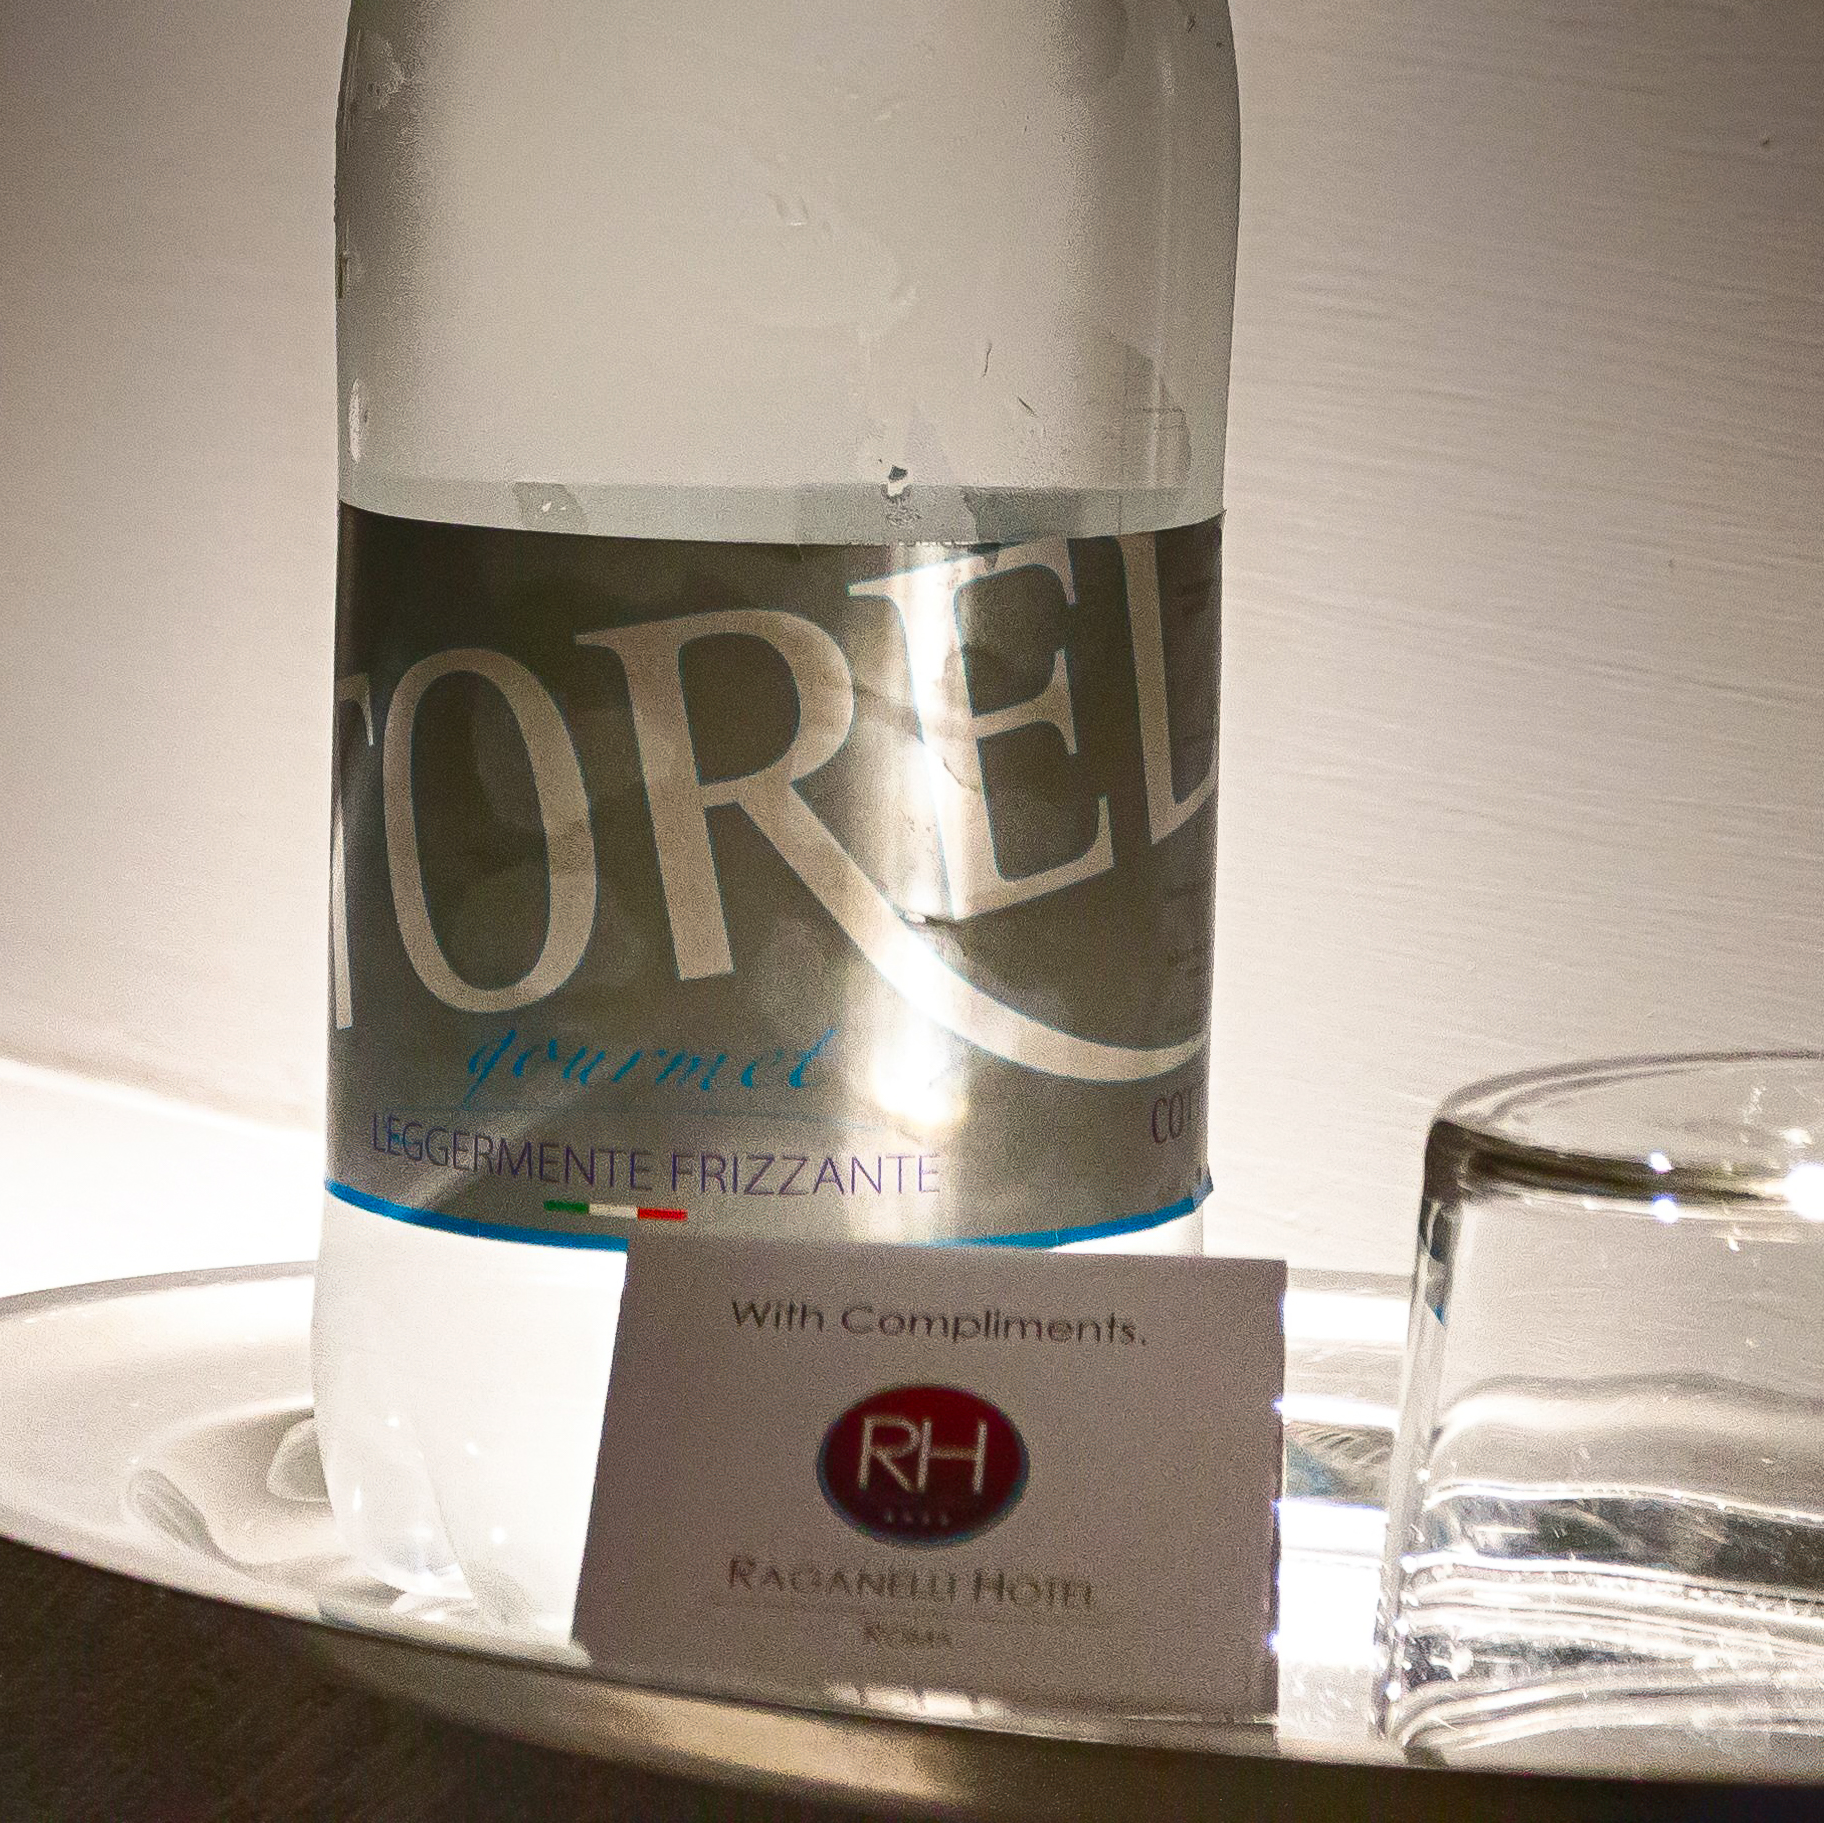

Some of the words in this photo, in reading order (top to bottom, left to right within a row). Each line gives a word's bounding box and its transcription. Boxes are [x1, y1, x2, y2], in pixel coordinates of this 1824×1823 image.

[465, 1027, 841, 1110] gourmet
[370, 1111, 654, 1192] LEGGERMENTE
[670, 1149, 942, 1197] FRIZZANTE
[731, 1299, 825, 1333] With
[840, 1302, 1148, 1346] Compliments.
[857, 1413, 989, 1496] RH
